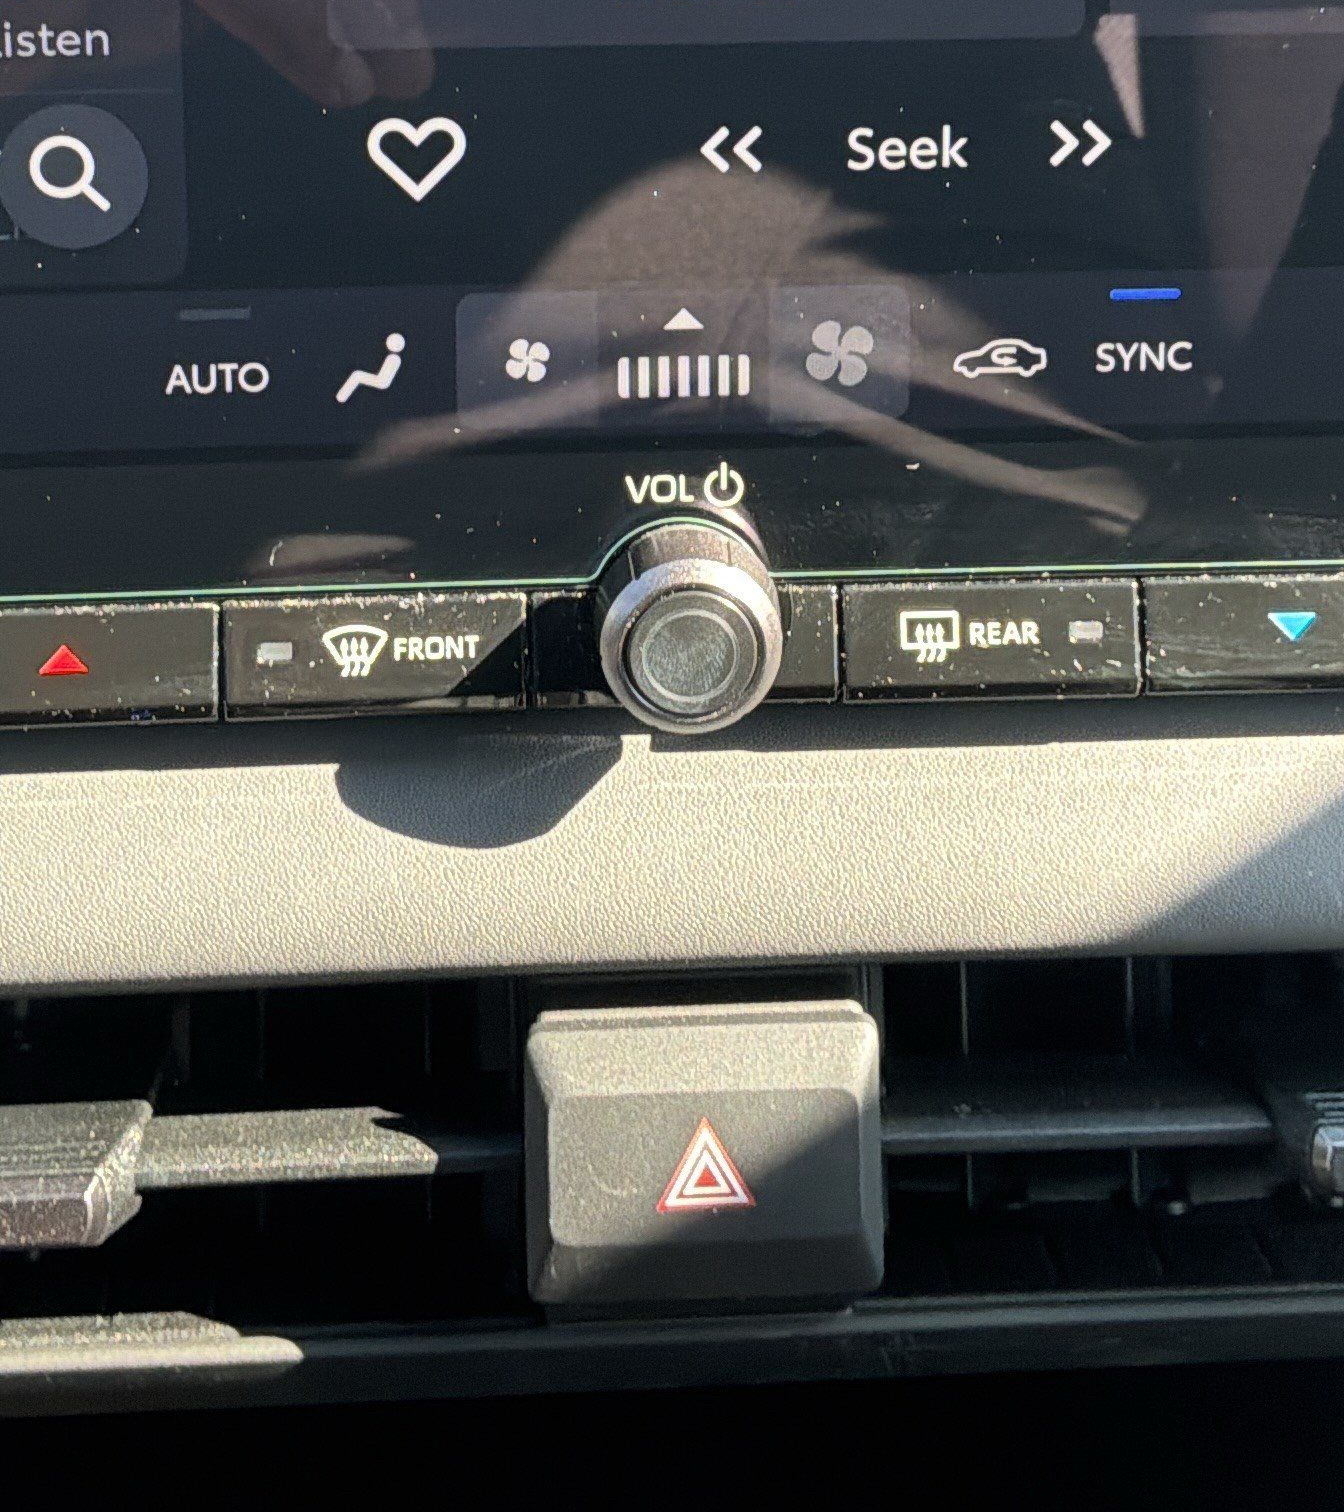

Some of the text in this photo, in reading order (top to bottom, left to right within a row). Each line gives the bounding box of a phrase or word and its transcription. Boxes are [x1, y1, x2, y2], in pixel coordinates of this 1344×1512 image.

[847, 124, 969, 171] Seek
[1095, 340, 1193, 373] SYNC
[165, 362, 270, 395] AUTO
[624, 473, 698, 504] VOL
[393, 634, 480, 662] FRONT
[968, 620, 1041, 649] REAR
